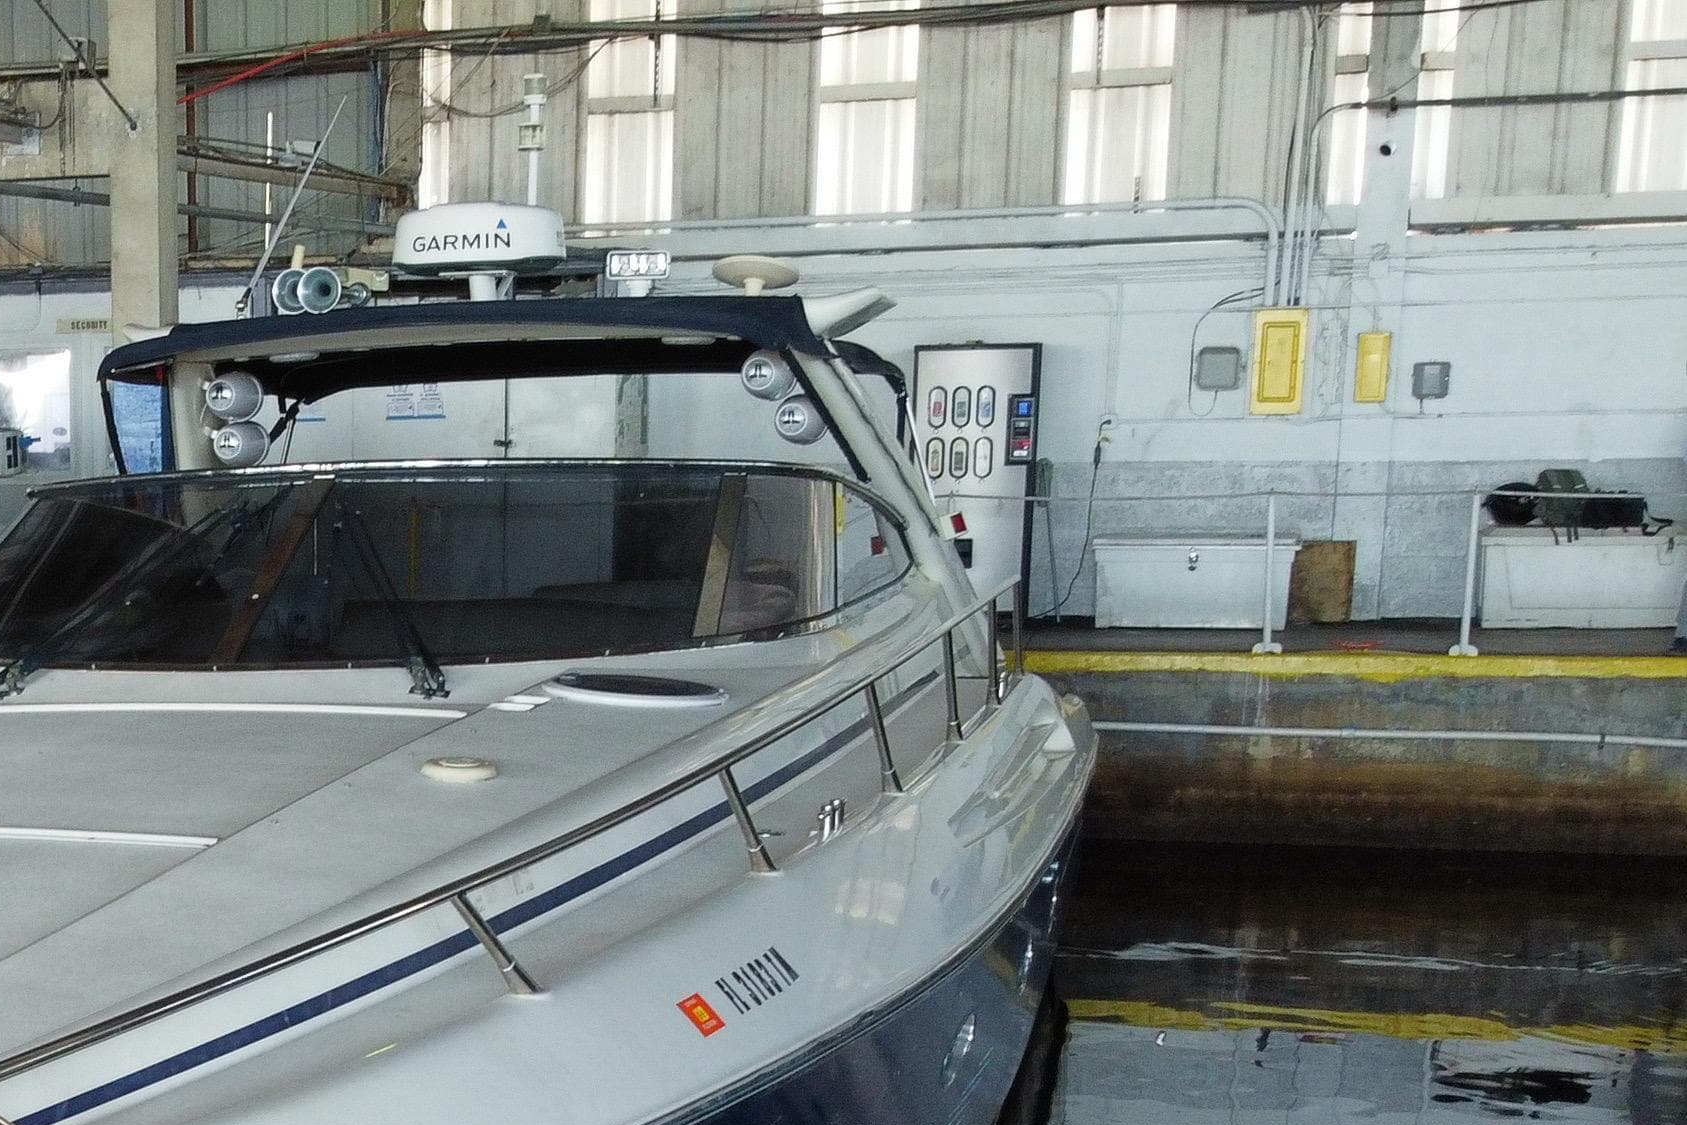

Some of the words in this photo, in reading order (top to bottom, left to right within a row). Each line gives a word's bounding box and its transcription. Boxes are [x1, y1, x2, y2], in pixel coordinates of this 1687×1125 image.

[412, 231, 512, 253] GARMIN
[714, 977, 751, 1015] FL
[731, 958, 783, 1006] 3183
